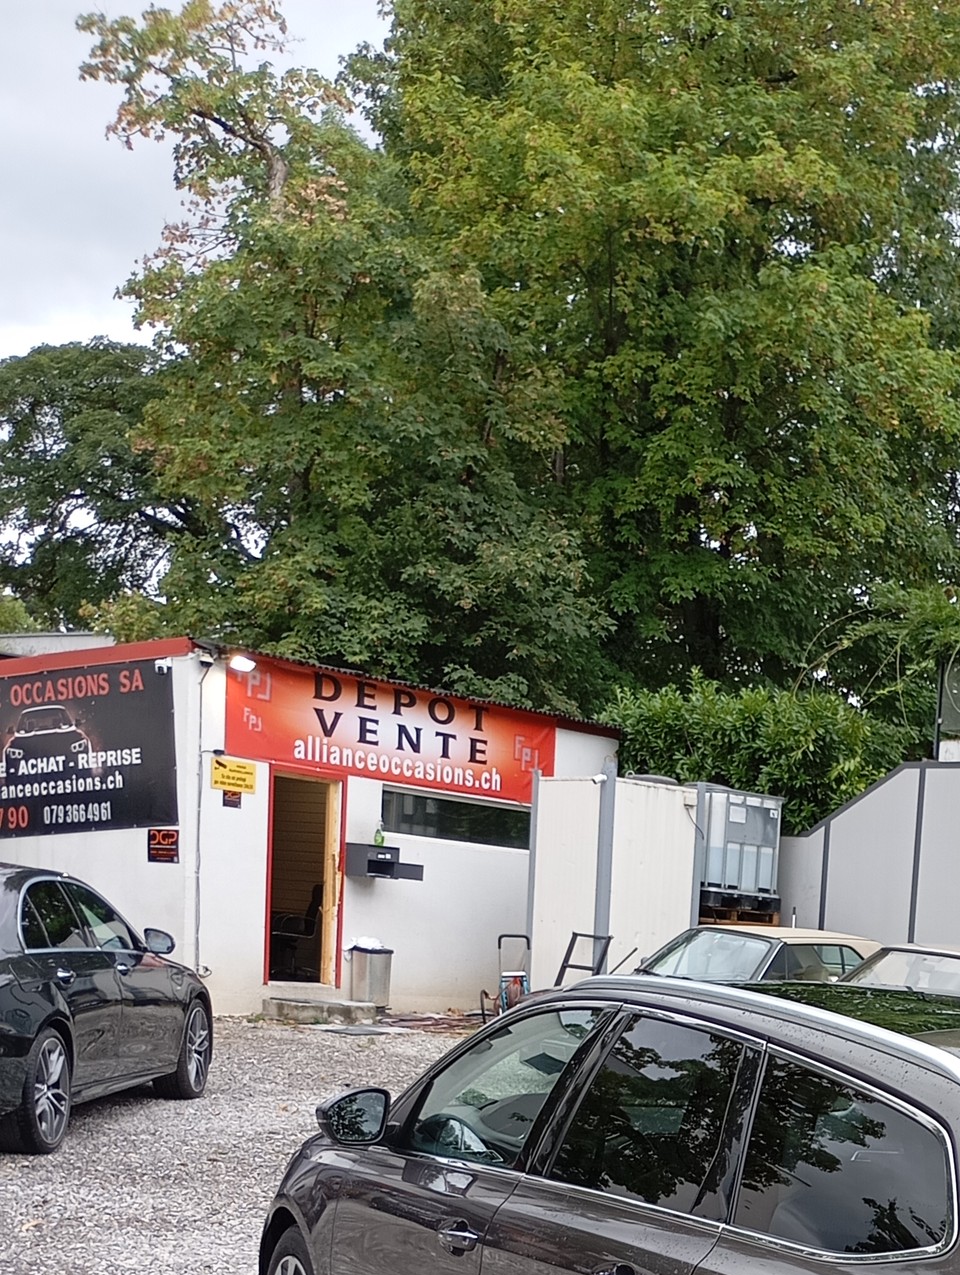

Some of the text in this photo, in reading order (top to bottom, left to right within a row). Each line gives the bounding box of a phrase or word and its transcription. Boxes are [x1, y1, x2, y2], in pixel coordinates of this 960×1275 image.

[10, 669, 144, 706] OCCASIONS SA
[312, 672, 489, 732] DEPOT
[312, 707, 488, 765] VENTE
[1, 770, 123, 799] anceoccasions.ch
[18, 756, 66, 776] ACHAT
[78, 748, 142, 769] REPRISE
[293, 735, 502, 792] allianceoccasions.ch
